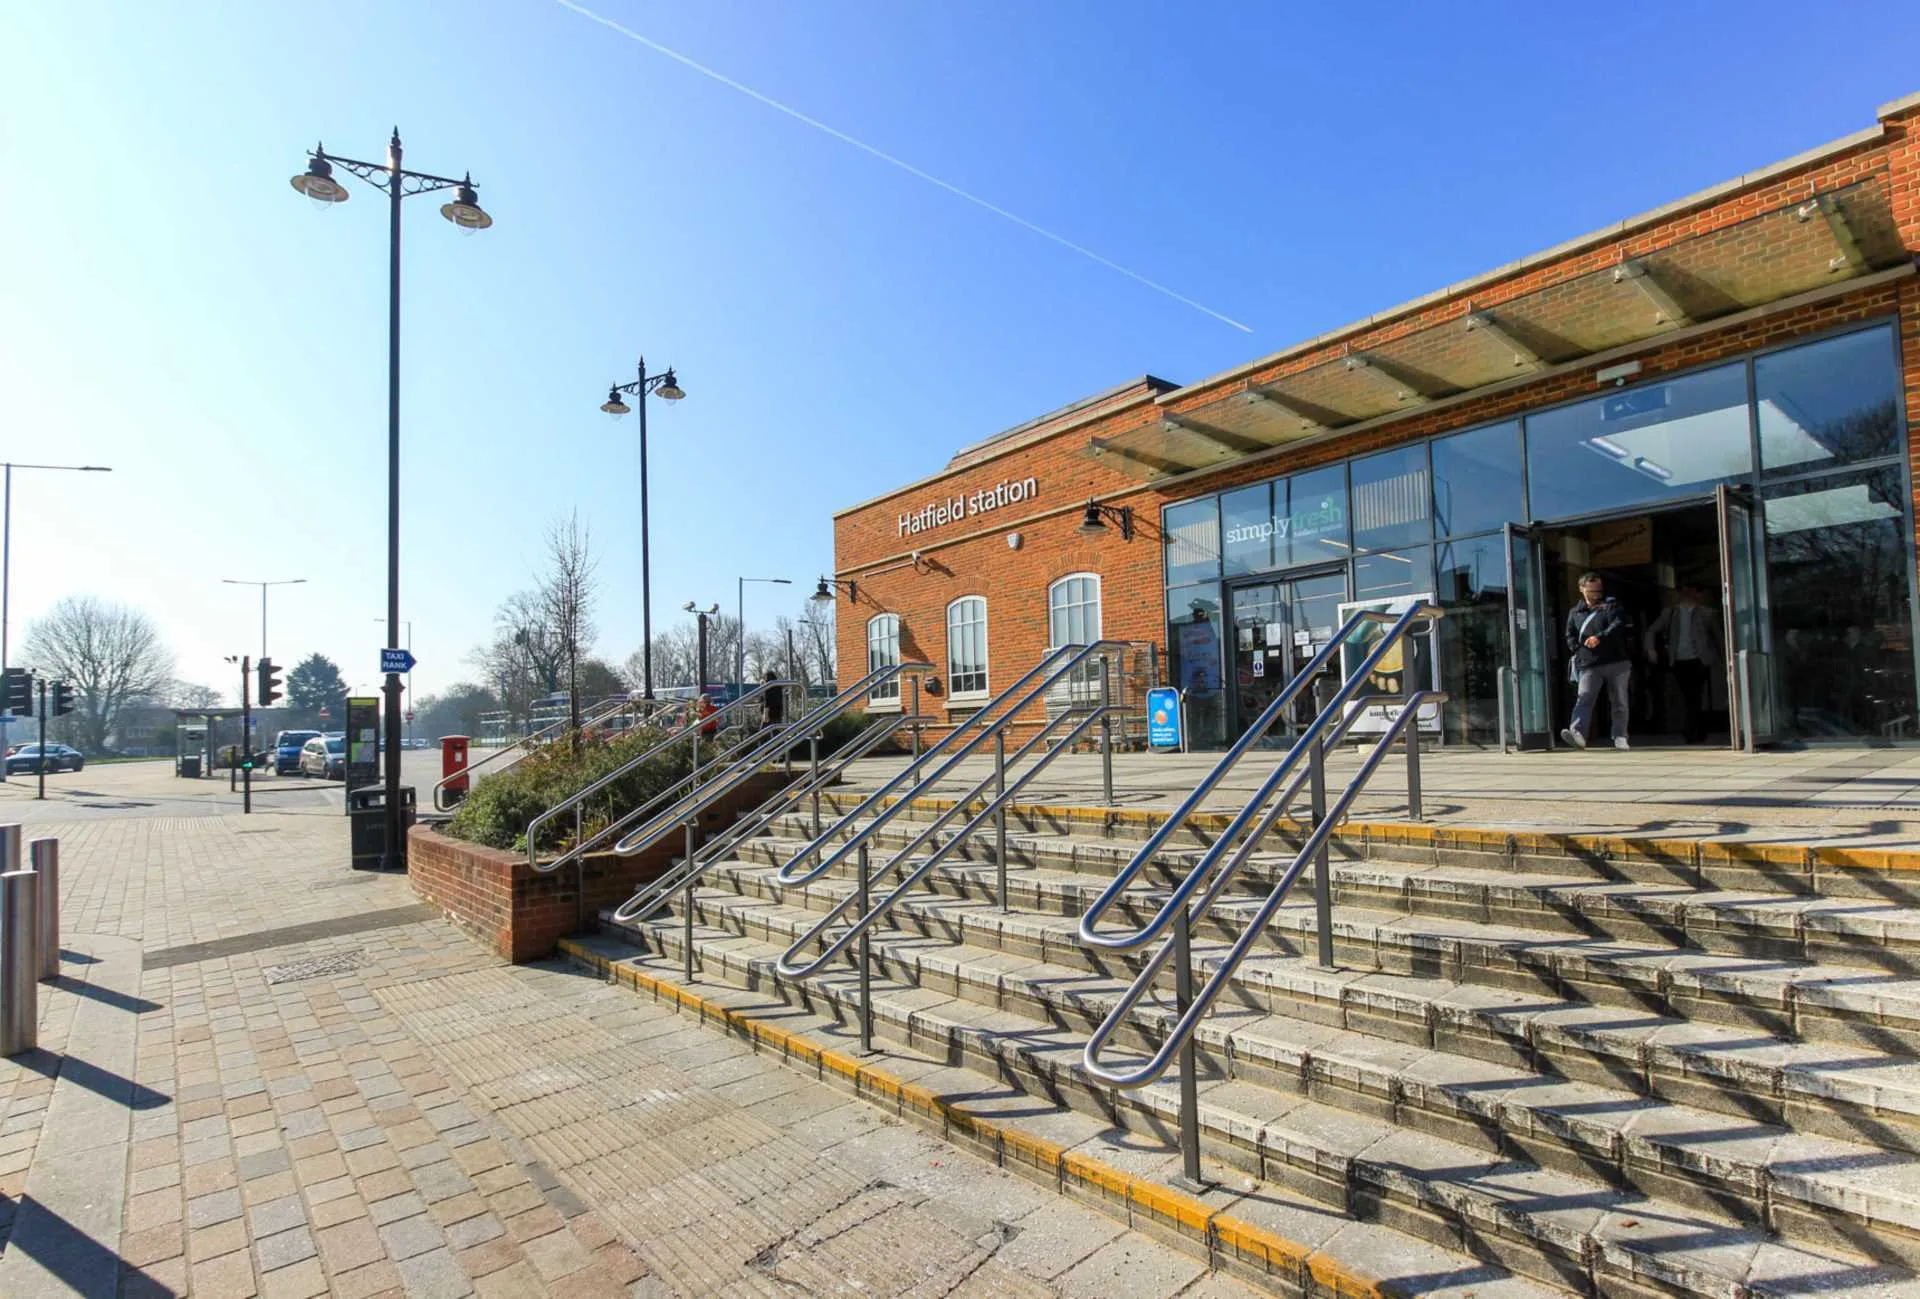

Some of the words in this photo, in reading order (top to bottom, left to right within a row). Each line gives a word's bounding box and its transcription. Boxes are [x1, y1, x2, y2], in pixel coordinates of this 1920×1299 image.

[898, 493, 964, 537] Hatfield
[968, 477, 1036, 515] station
[386, 652, 405, 660] TAXI
[383, 661, 408, 669] RANK
